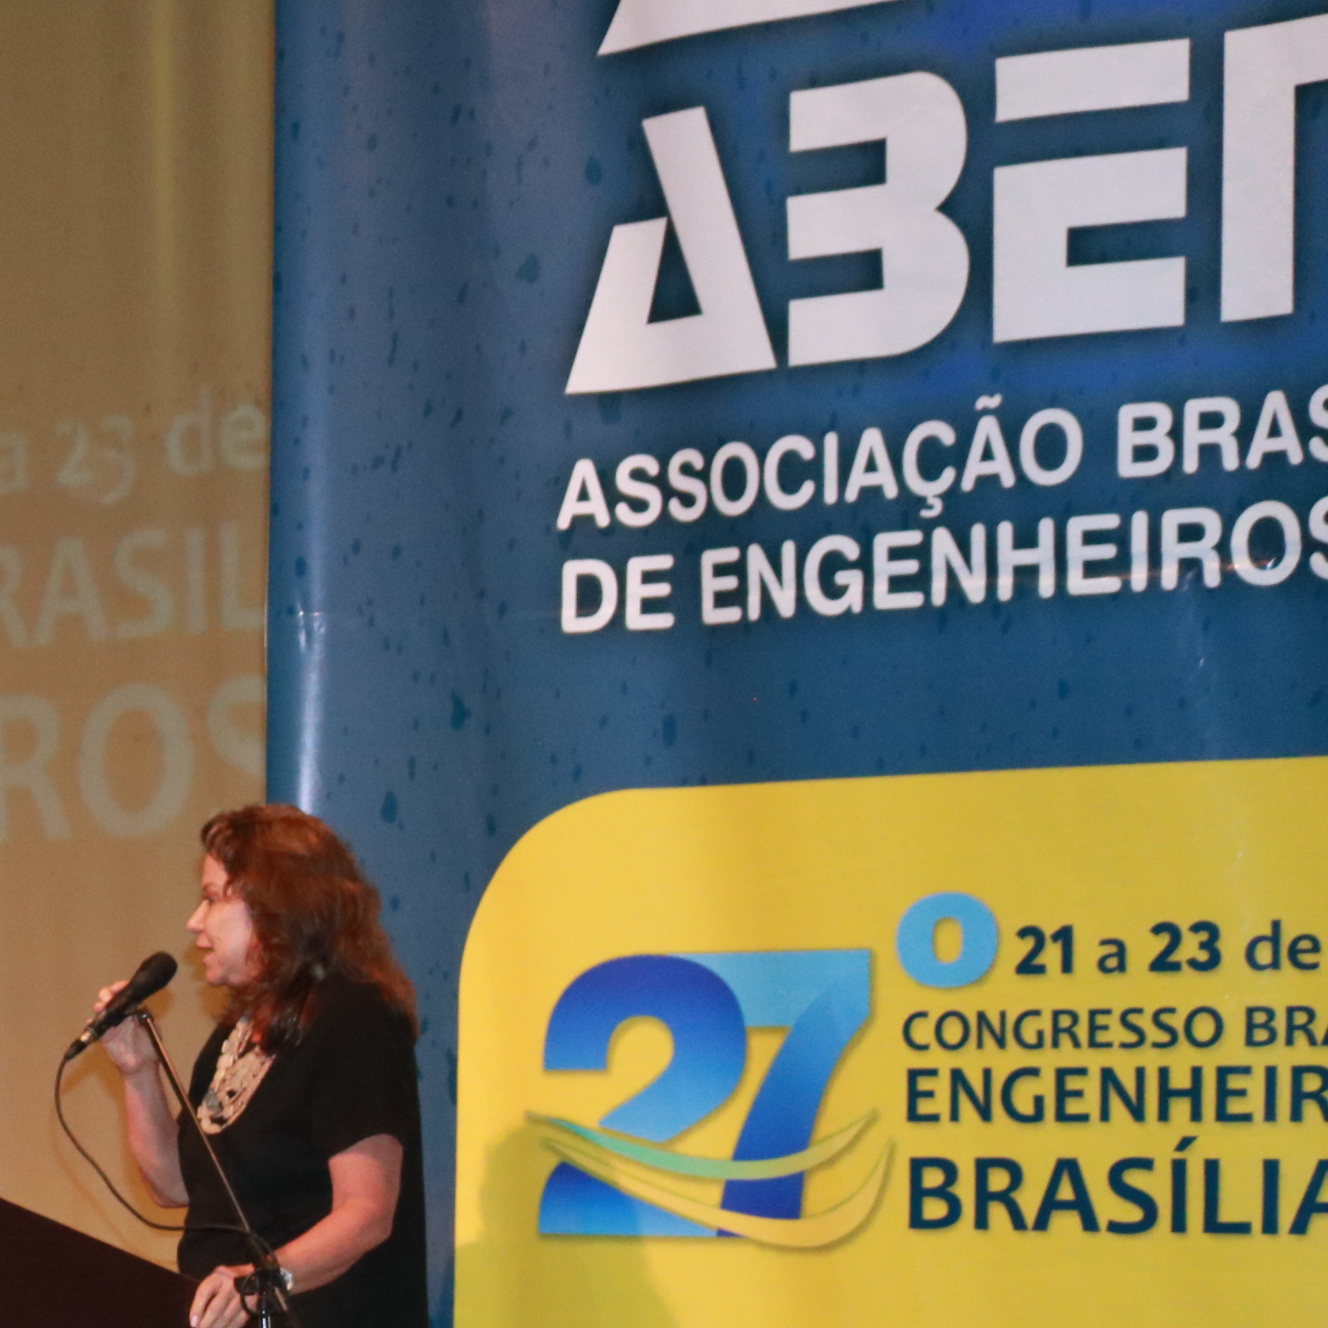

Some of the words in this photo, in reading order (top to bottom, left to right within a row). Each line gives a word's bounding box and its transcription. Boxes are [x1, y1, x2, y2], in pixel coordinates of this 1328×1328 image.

[54, 413, 136, 507] 23
[165, 391, 267, 476] de
[556, 393, 1084, 530] ASSOCIAÇÃO
[561, 554, 675, 633] DE
[1015, 924, 1074, 974] 21
[1097, 937, 1127, 974] a
[1148, 920, 1222, 972] 23
[1244, 919, 1321, 971] de
[902, 1005, 1225, 1051] CONGRESSO
[1244, 1005, 1328, 1047] BR
[906, 1065, 1328, 1124] ENGENHEIR
